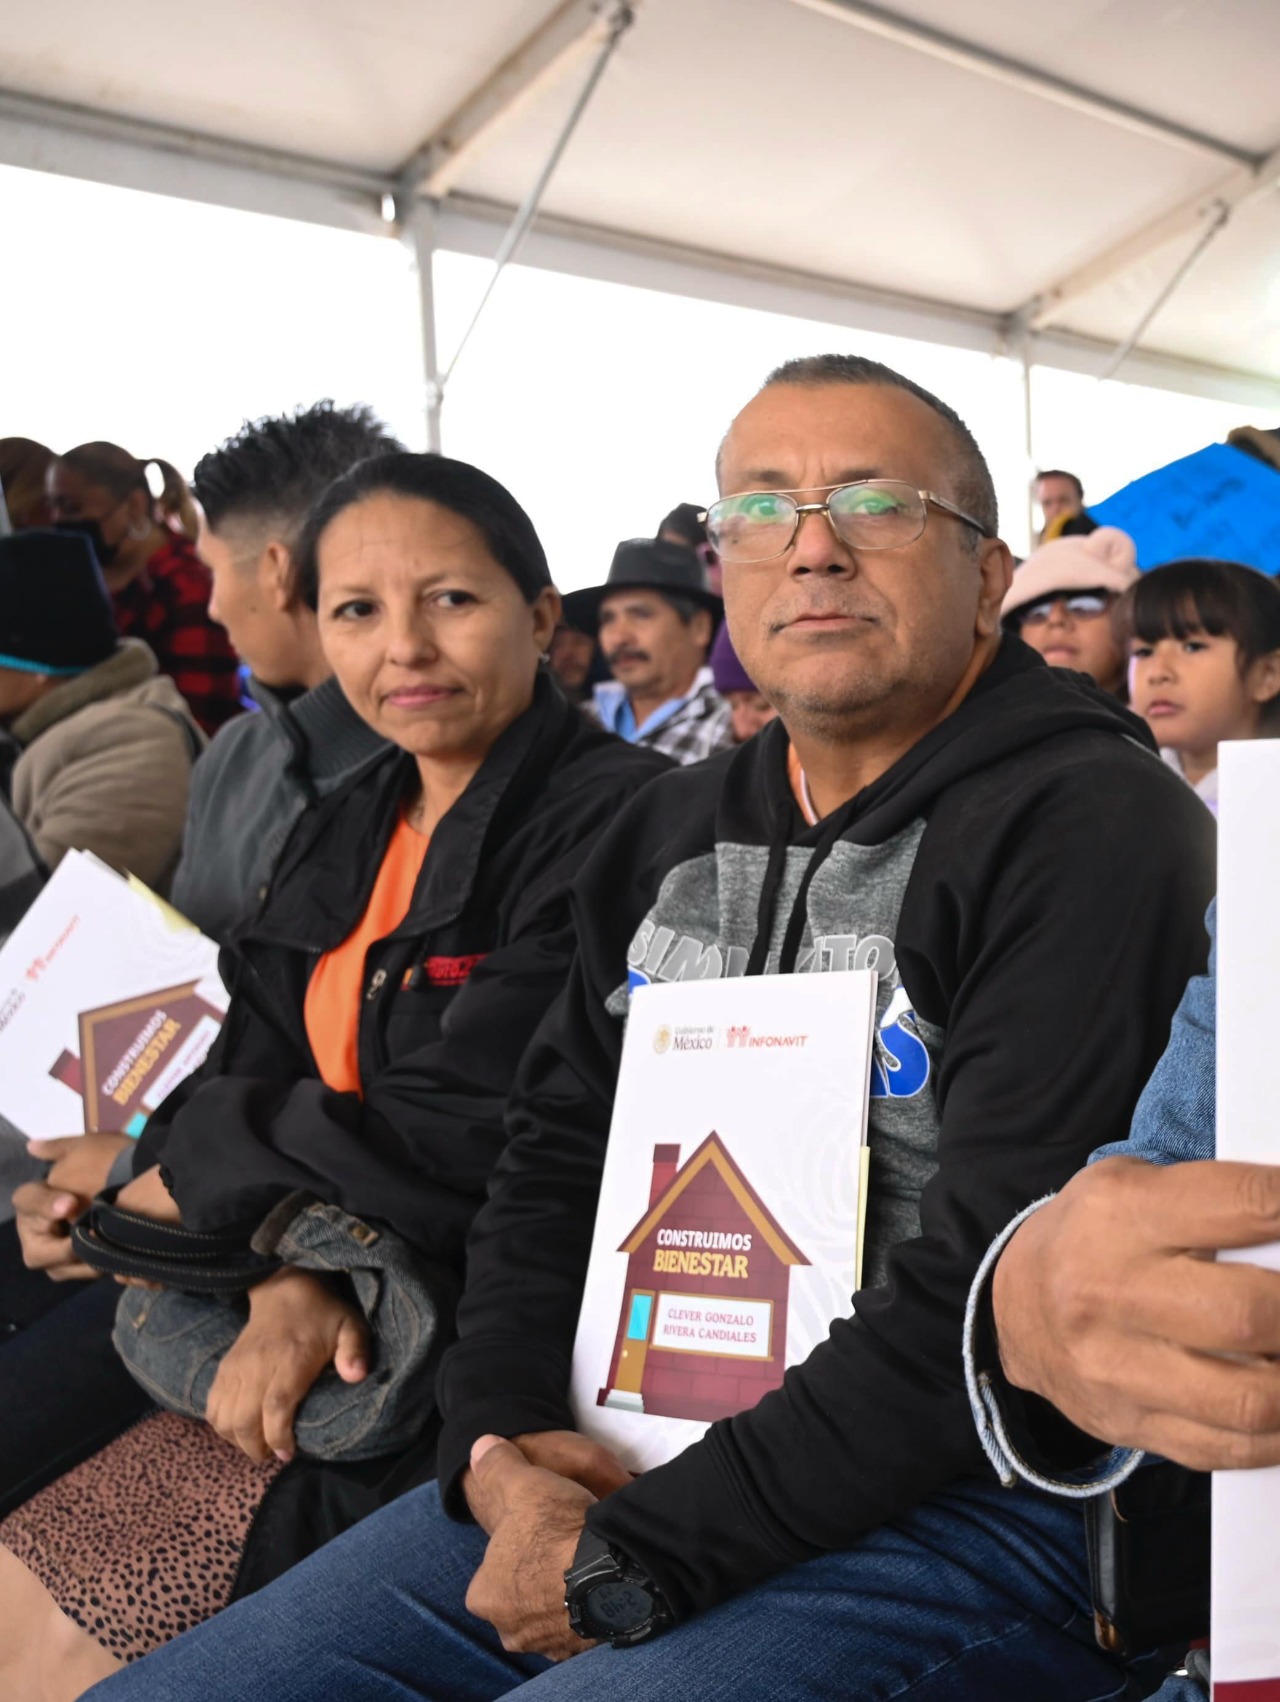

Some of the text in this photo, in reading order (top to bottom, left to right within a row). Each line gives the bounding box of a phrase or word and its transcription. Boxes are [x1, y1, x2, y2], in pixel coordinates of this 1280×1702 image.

[673, 1035, 713, 1051] México
[749, 1035, 808, 1048] INFONAVIT
[657, 1229, 752, 1251] CONSTRUIMOS
[653, 1249, 749, 1279] BIENESTAR
[667, 1308, 754, 1326] CLEVER GONZALO
[663, 1324, 757, 1343] RIVERA CANDIALES
